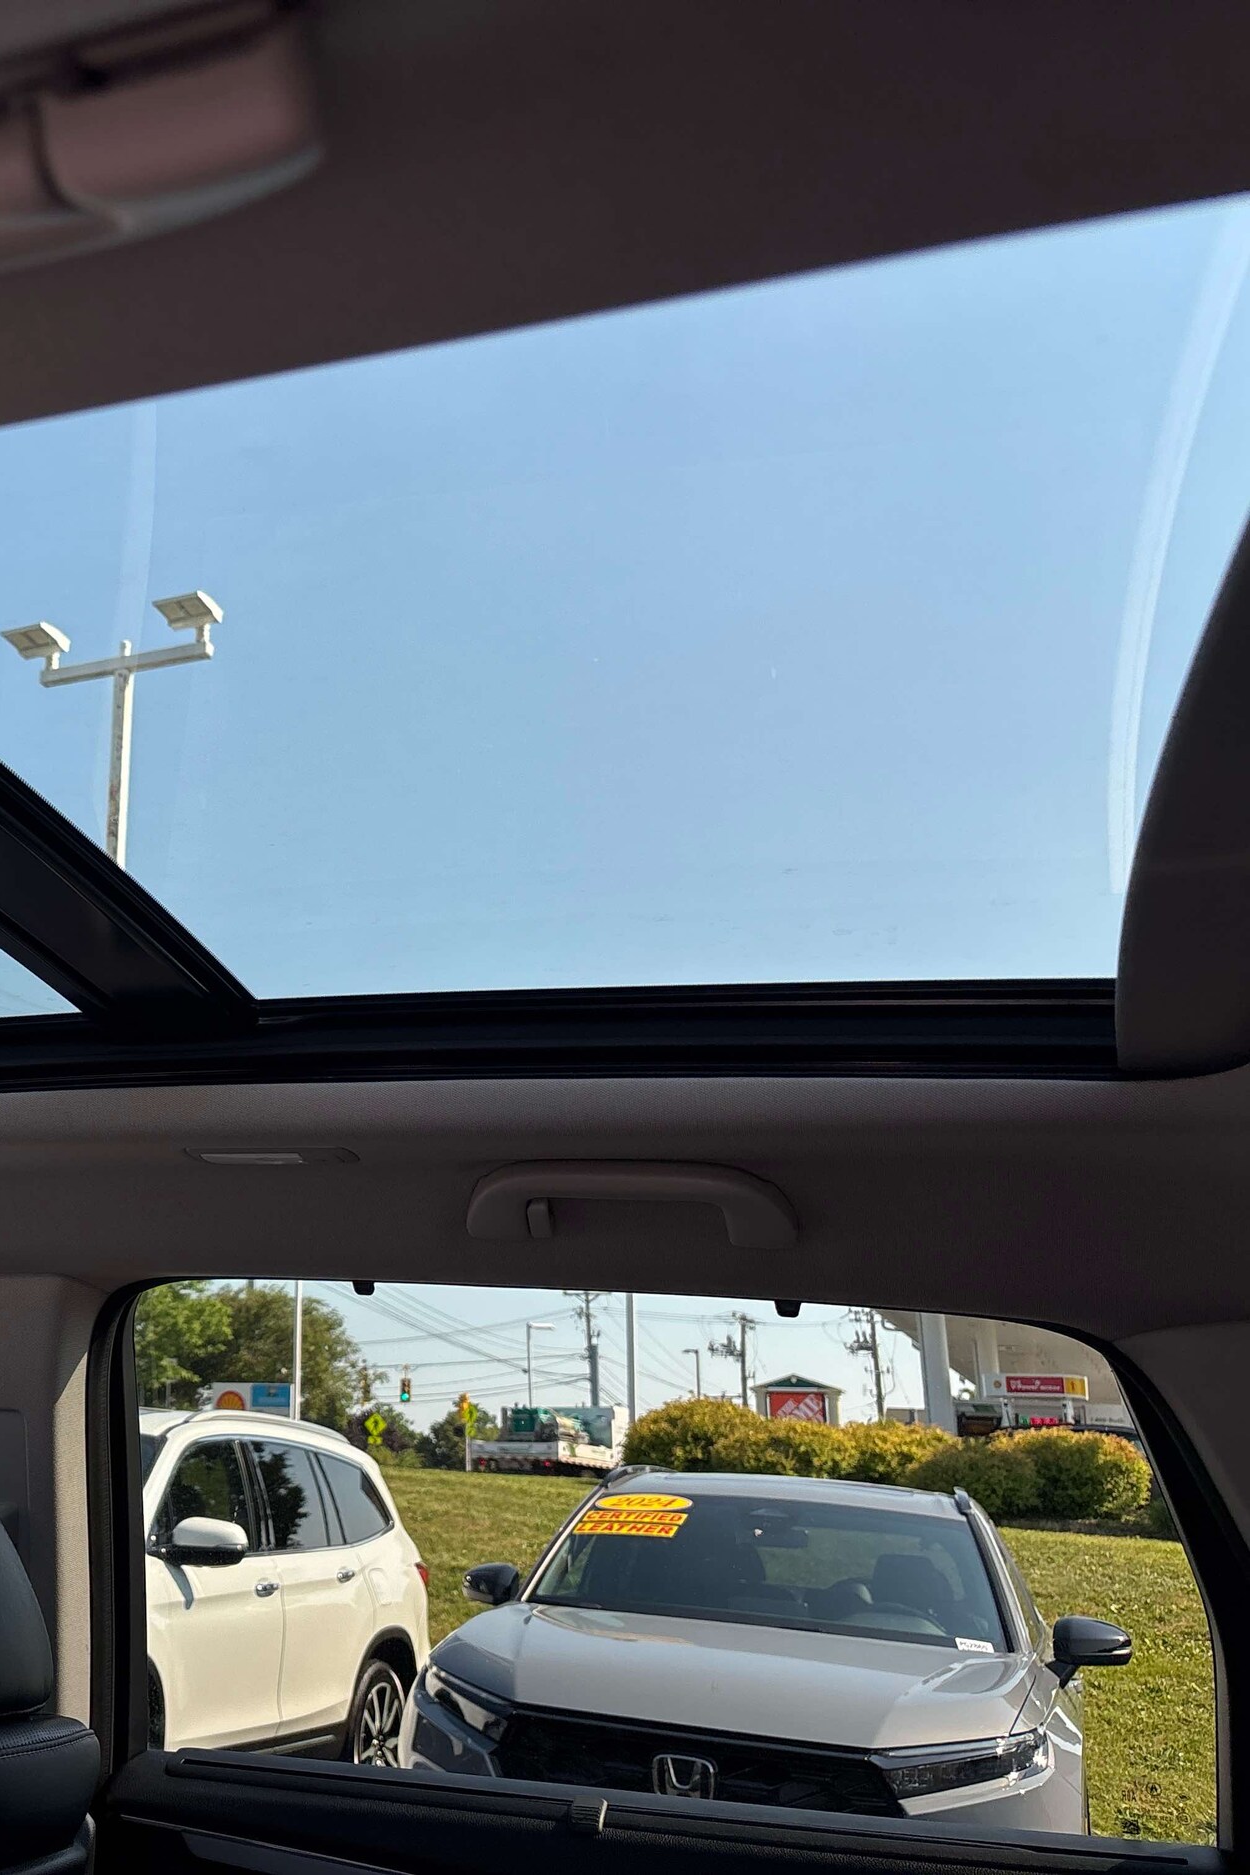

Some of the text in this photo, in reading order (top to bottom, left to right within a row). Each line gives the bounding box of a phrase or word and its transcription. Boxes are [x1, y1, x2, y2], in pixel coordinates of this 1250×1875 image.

[611, 1497, 678, 1507] 2024
[586, 1511, 683, 1522] CERTIFIED
[576, 1522, 674, 1534] LEATHER
